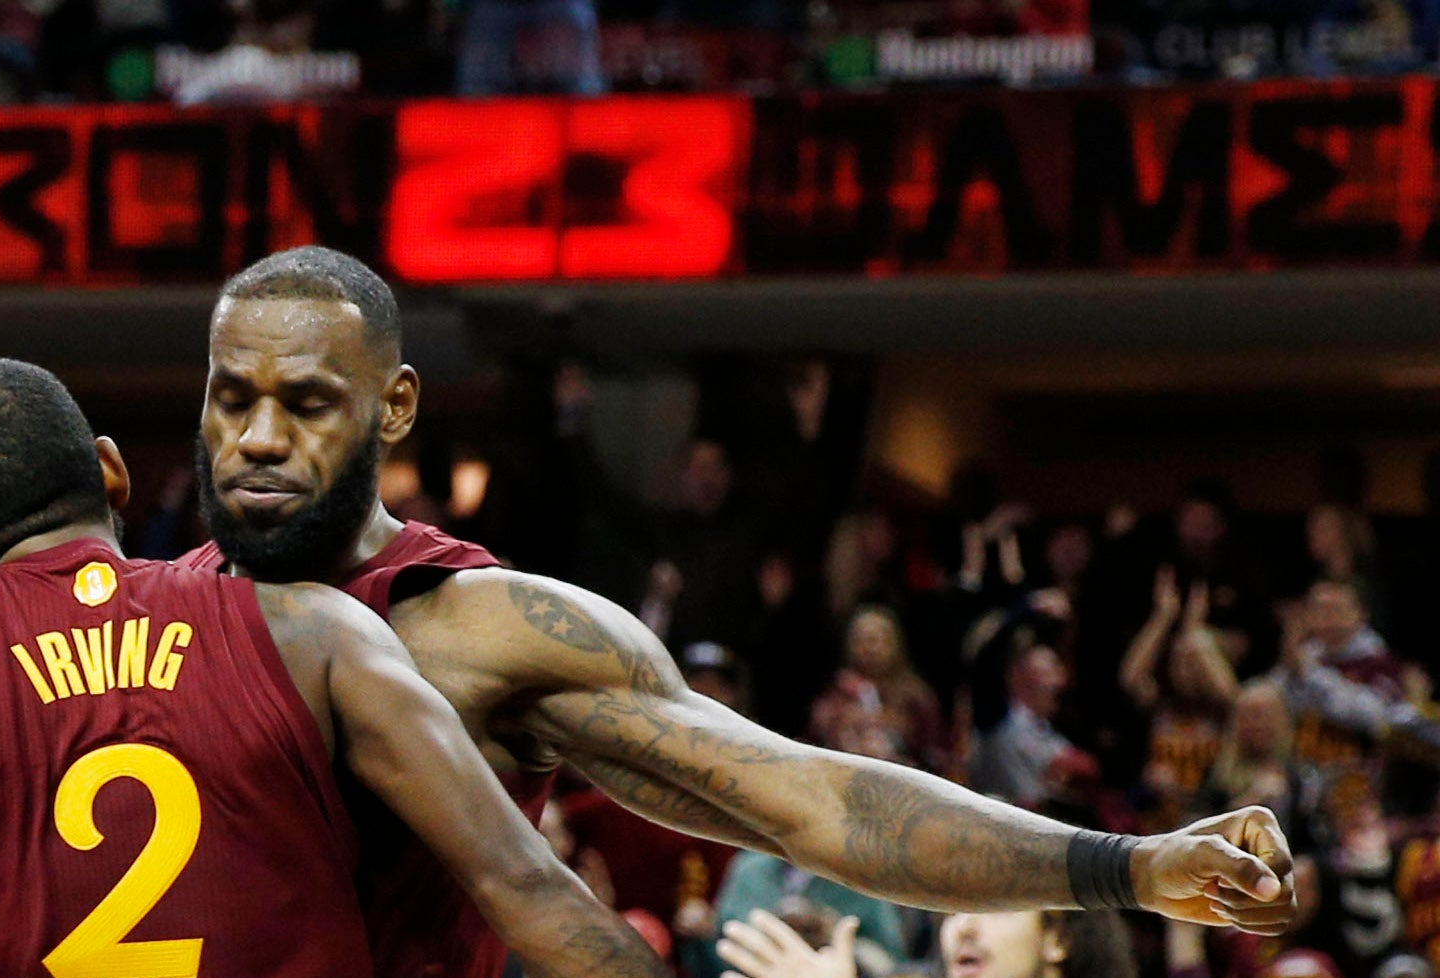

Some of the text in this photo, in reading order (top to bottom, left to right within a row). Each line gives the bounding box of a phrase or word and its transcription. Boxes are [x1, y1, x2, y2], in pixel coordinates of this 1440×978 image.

[388, 95, 740, 282] 23
[758, 96, 1440, 272] JAME
[10, 616, 193, 704] IRVING
